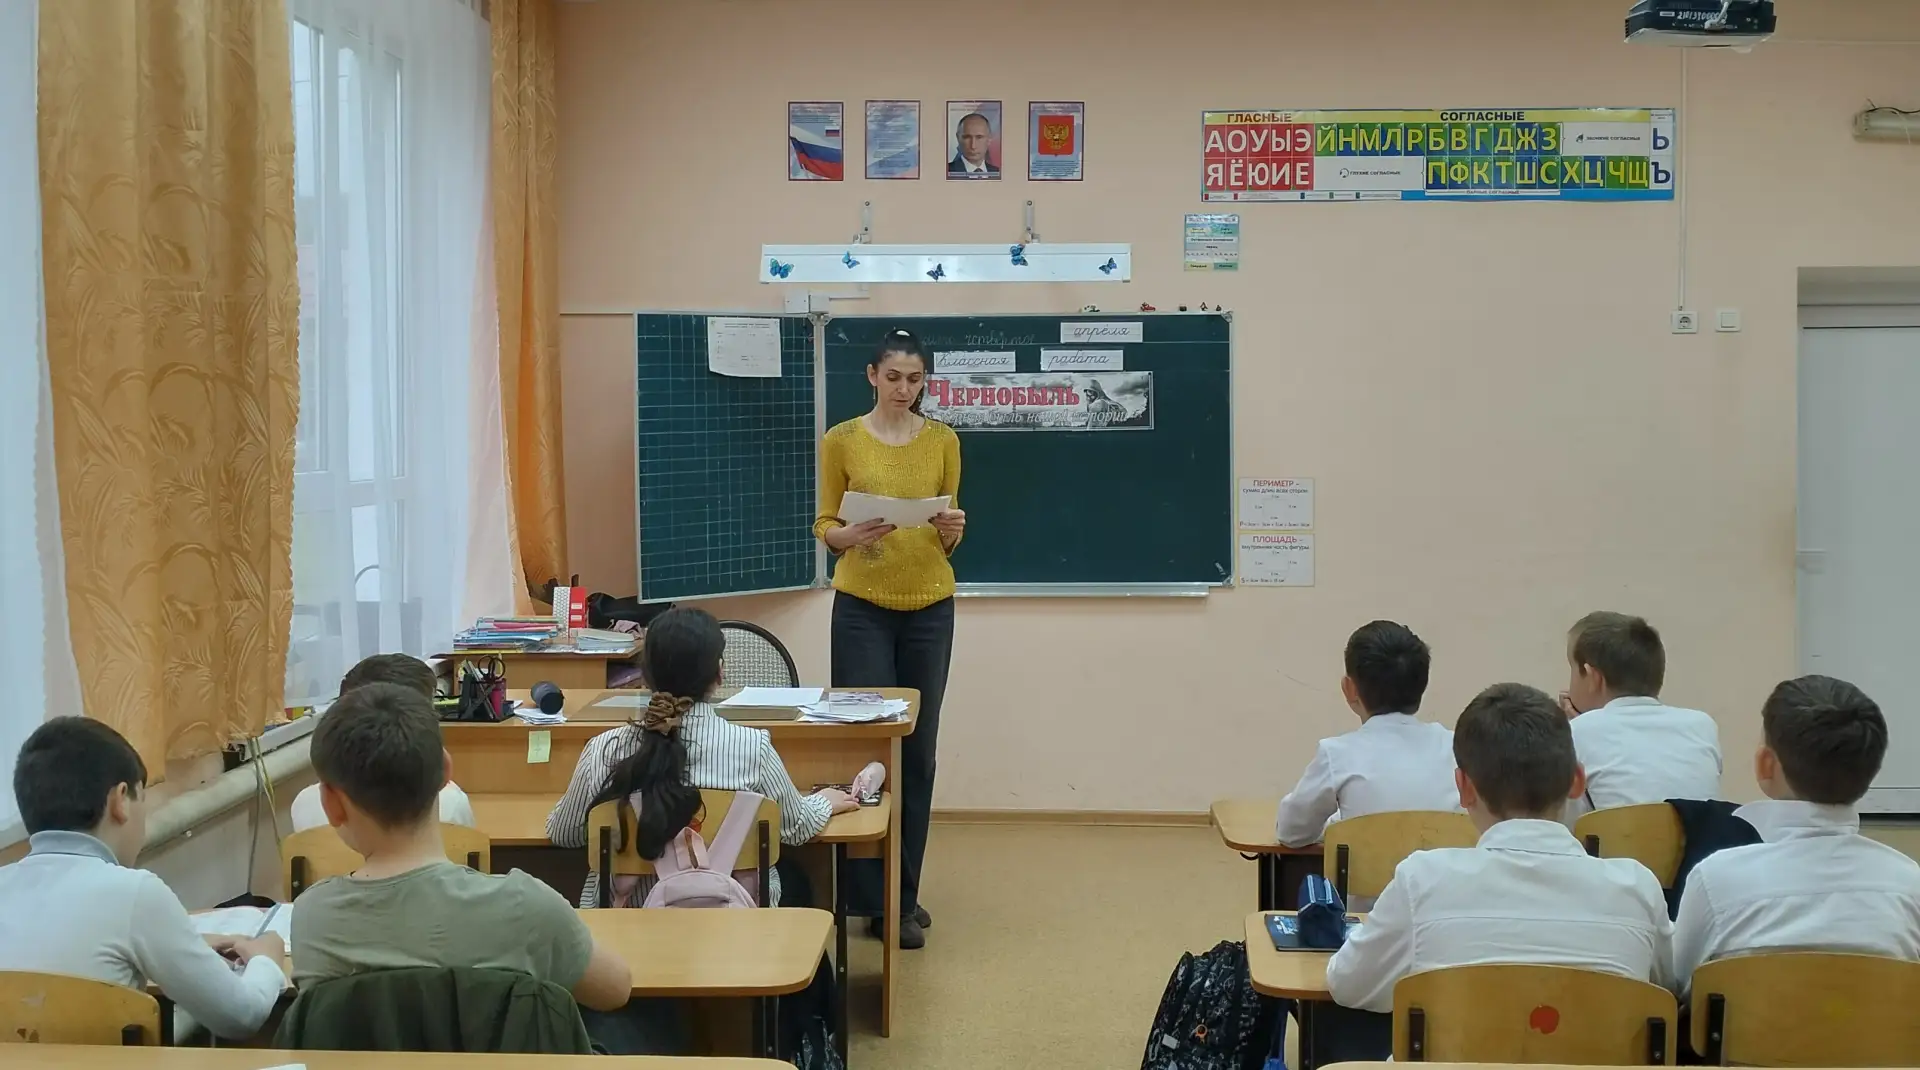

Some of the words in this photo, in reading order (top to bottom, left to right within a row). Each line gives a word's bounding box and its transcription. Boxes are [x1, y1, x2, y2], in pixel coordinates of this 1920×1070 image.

[1227, 113, 1292, 123] ГЛАСНЫЕ
[1440, 111, 1525, 121] СОГЛАСНЫЕ
[1253, 479, 1294, 487] ПЕРИМЕТР
[1252, 535, 1298, 544] ПЛОЩАДЬ
